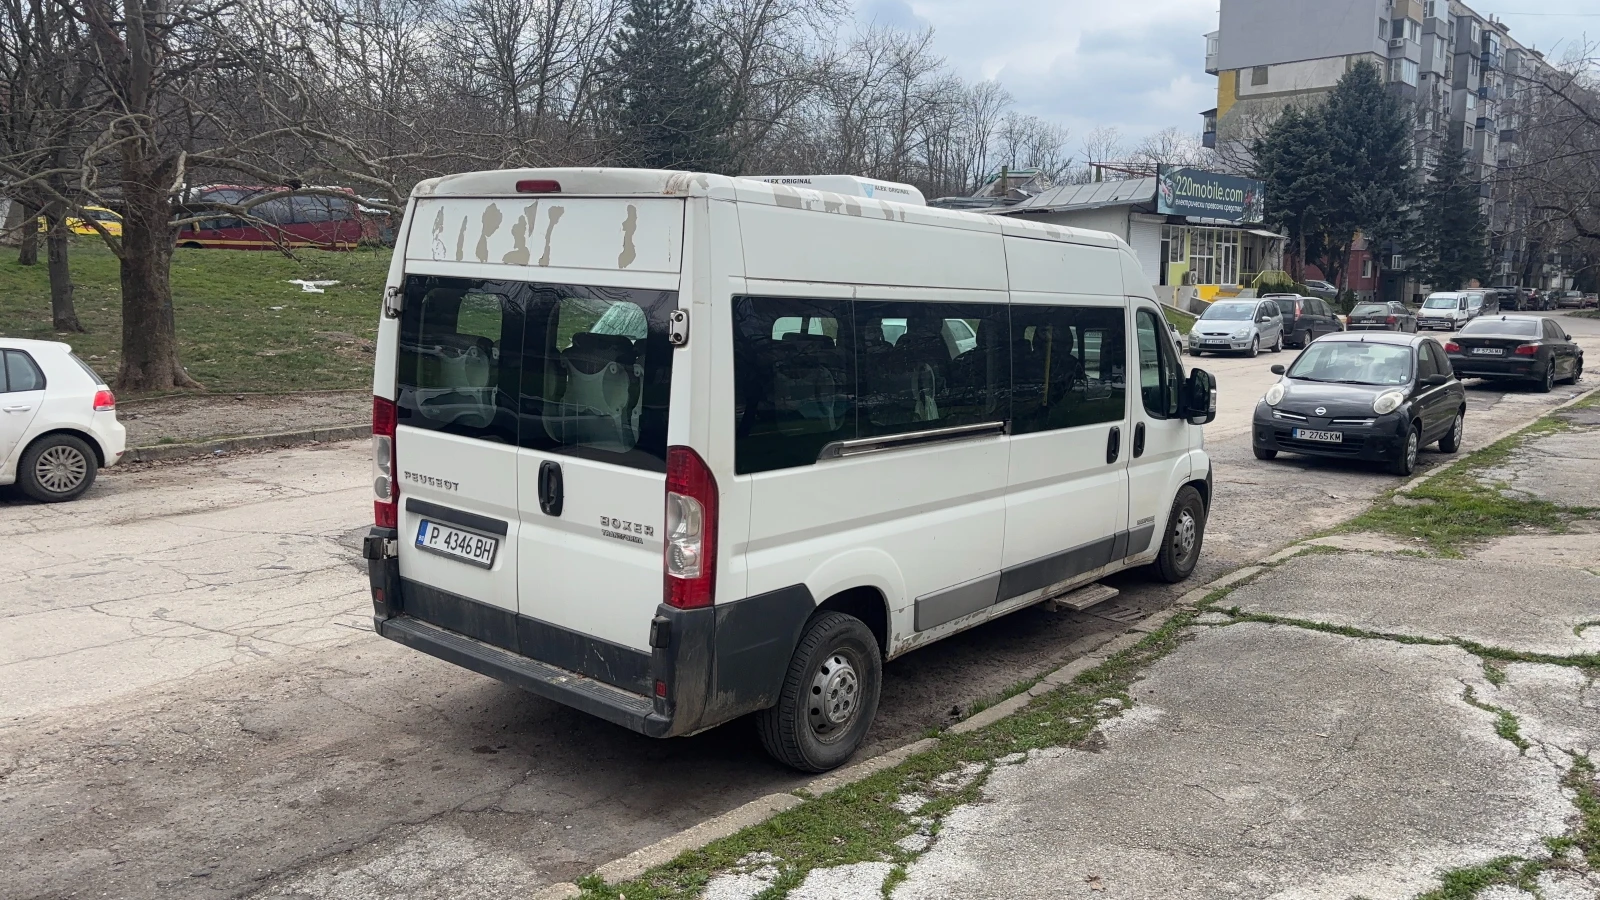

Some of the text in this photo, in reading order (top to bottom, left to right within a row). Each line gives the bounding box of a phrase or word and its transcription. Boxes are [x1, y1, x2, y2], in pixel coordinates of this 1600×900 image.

[1176, 176, 1243, 202] 220mobile.com
[404, 470, 459, 491] PEUGEOT
[430, 526, 440, 544] P
[600, 516, 654, 536] BOXER
